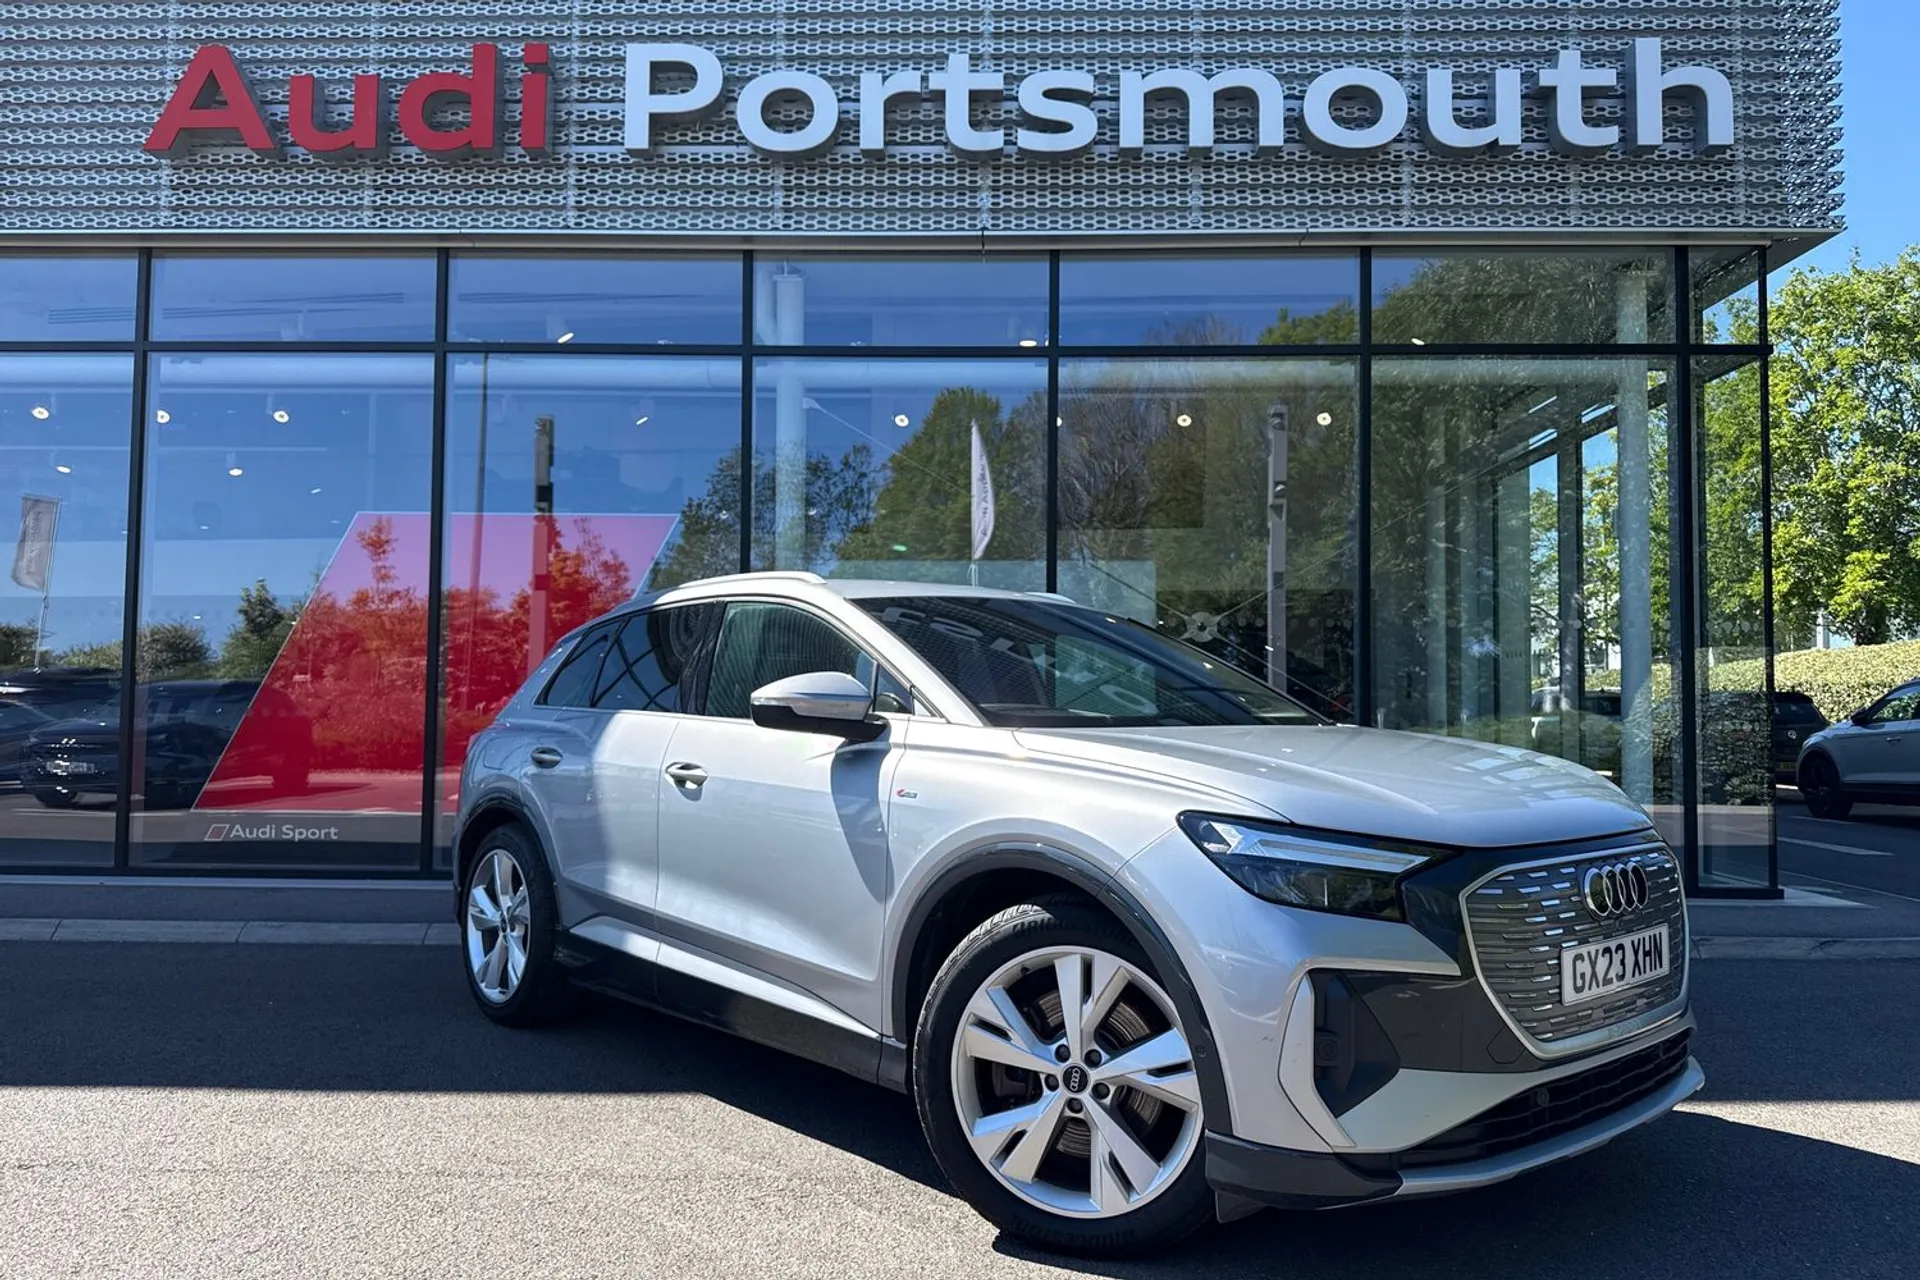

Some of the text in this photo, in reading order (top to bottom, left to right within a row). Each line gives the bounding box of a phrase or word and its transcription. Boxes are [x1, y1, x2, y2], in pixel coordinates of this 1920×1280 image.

[144, 37, 1735, 154] Audi Portsmouth
[230, 824, 339, 842] Audi Sport
[1572, 931, 1663, 994] GX23 XHN
